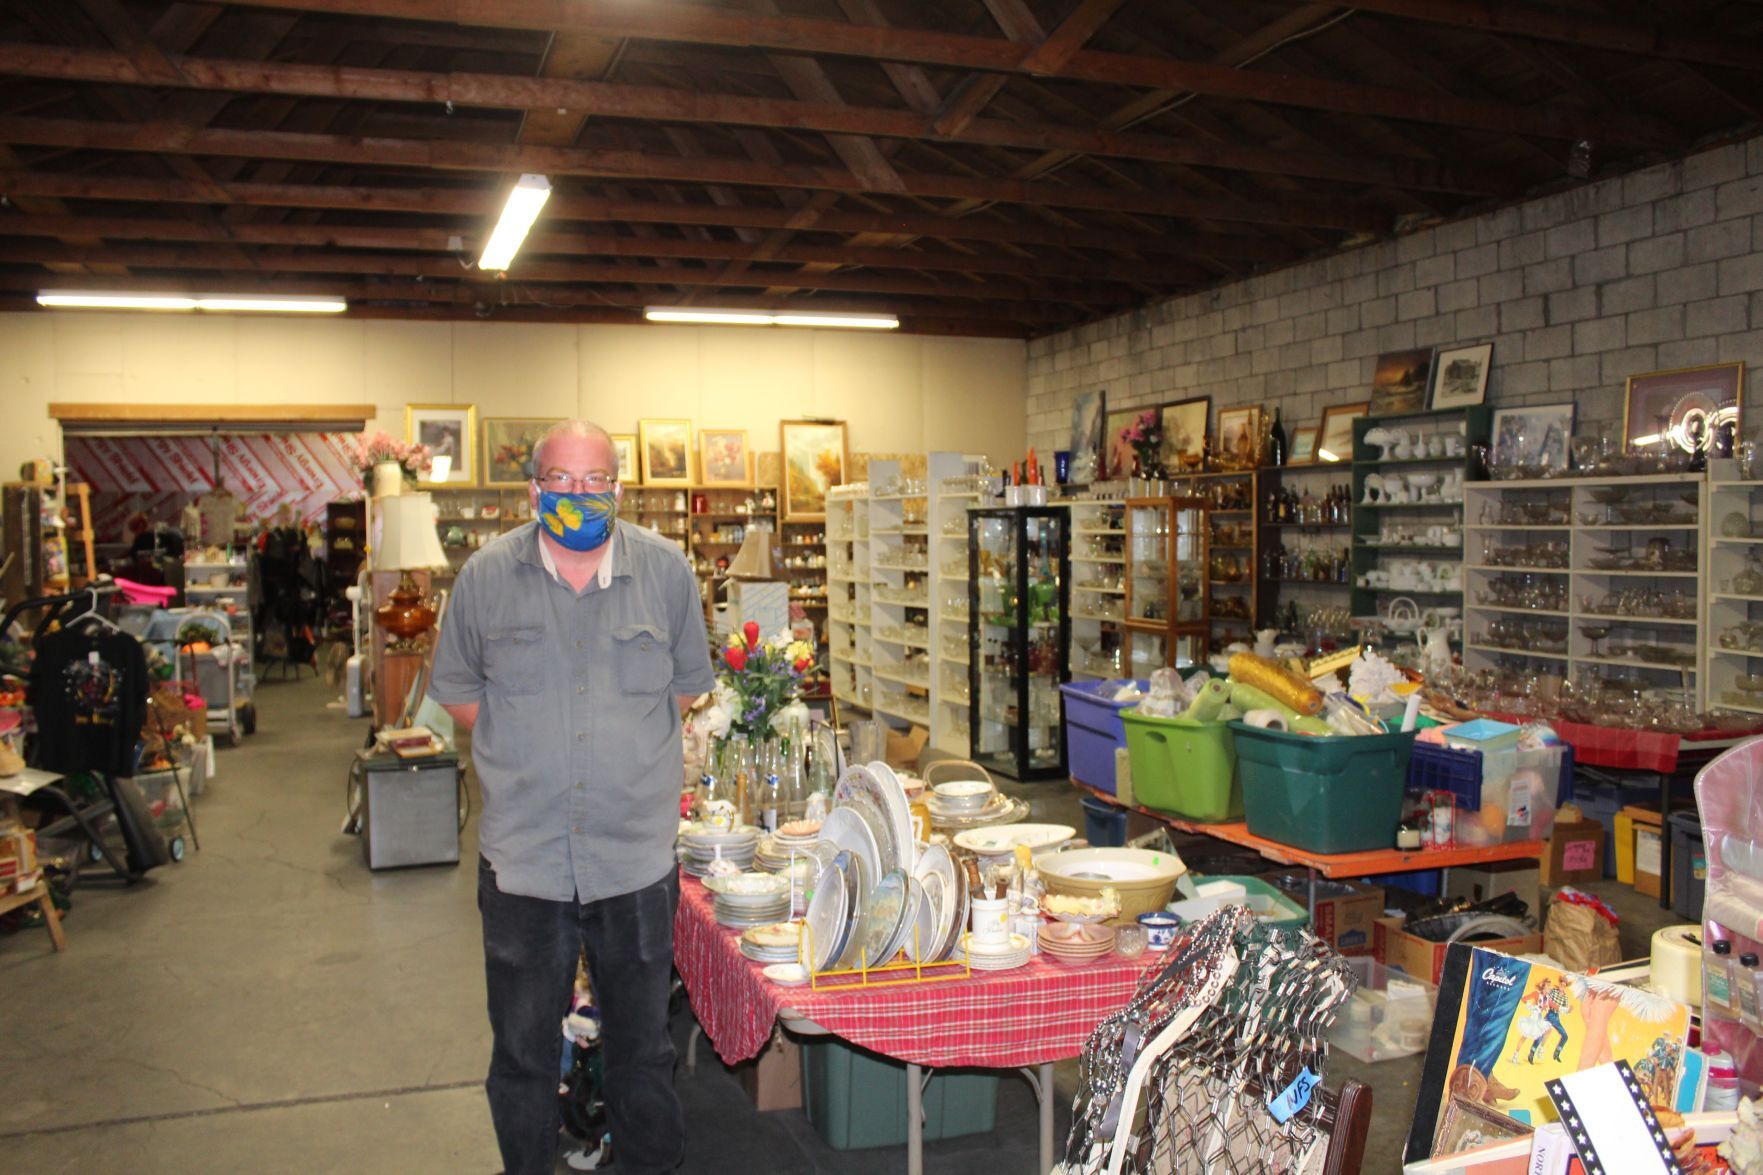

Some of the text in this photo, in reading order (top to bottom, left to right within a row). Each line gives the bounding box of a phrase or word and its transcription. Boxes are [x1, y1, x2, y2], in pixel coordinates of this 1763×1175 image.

[169, 452, 199, 484] Shield
[239, 453, 266, 490] Energy
[297, 453, 324, 490] Energy
[1482, 967, 1517, 986] Capitol
[1286, 1076, 1310, 1110] NFS
